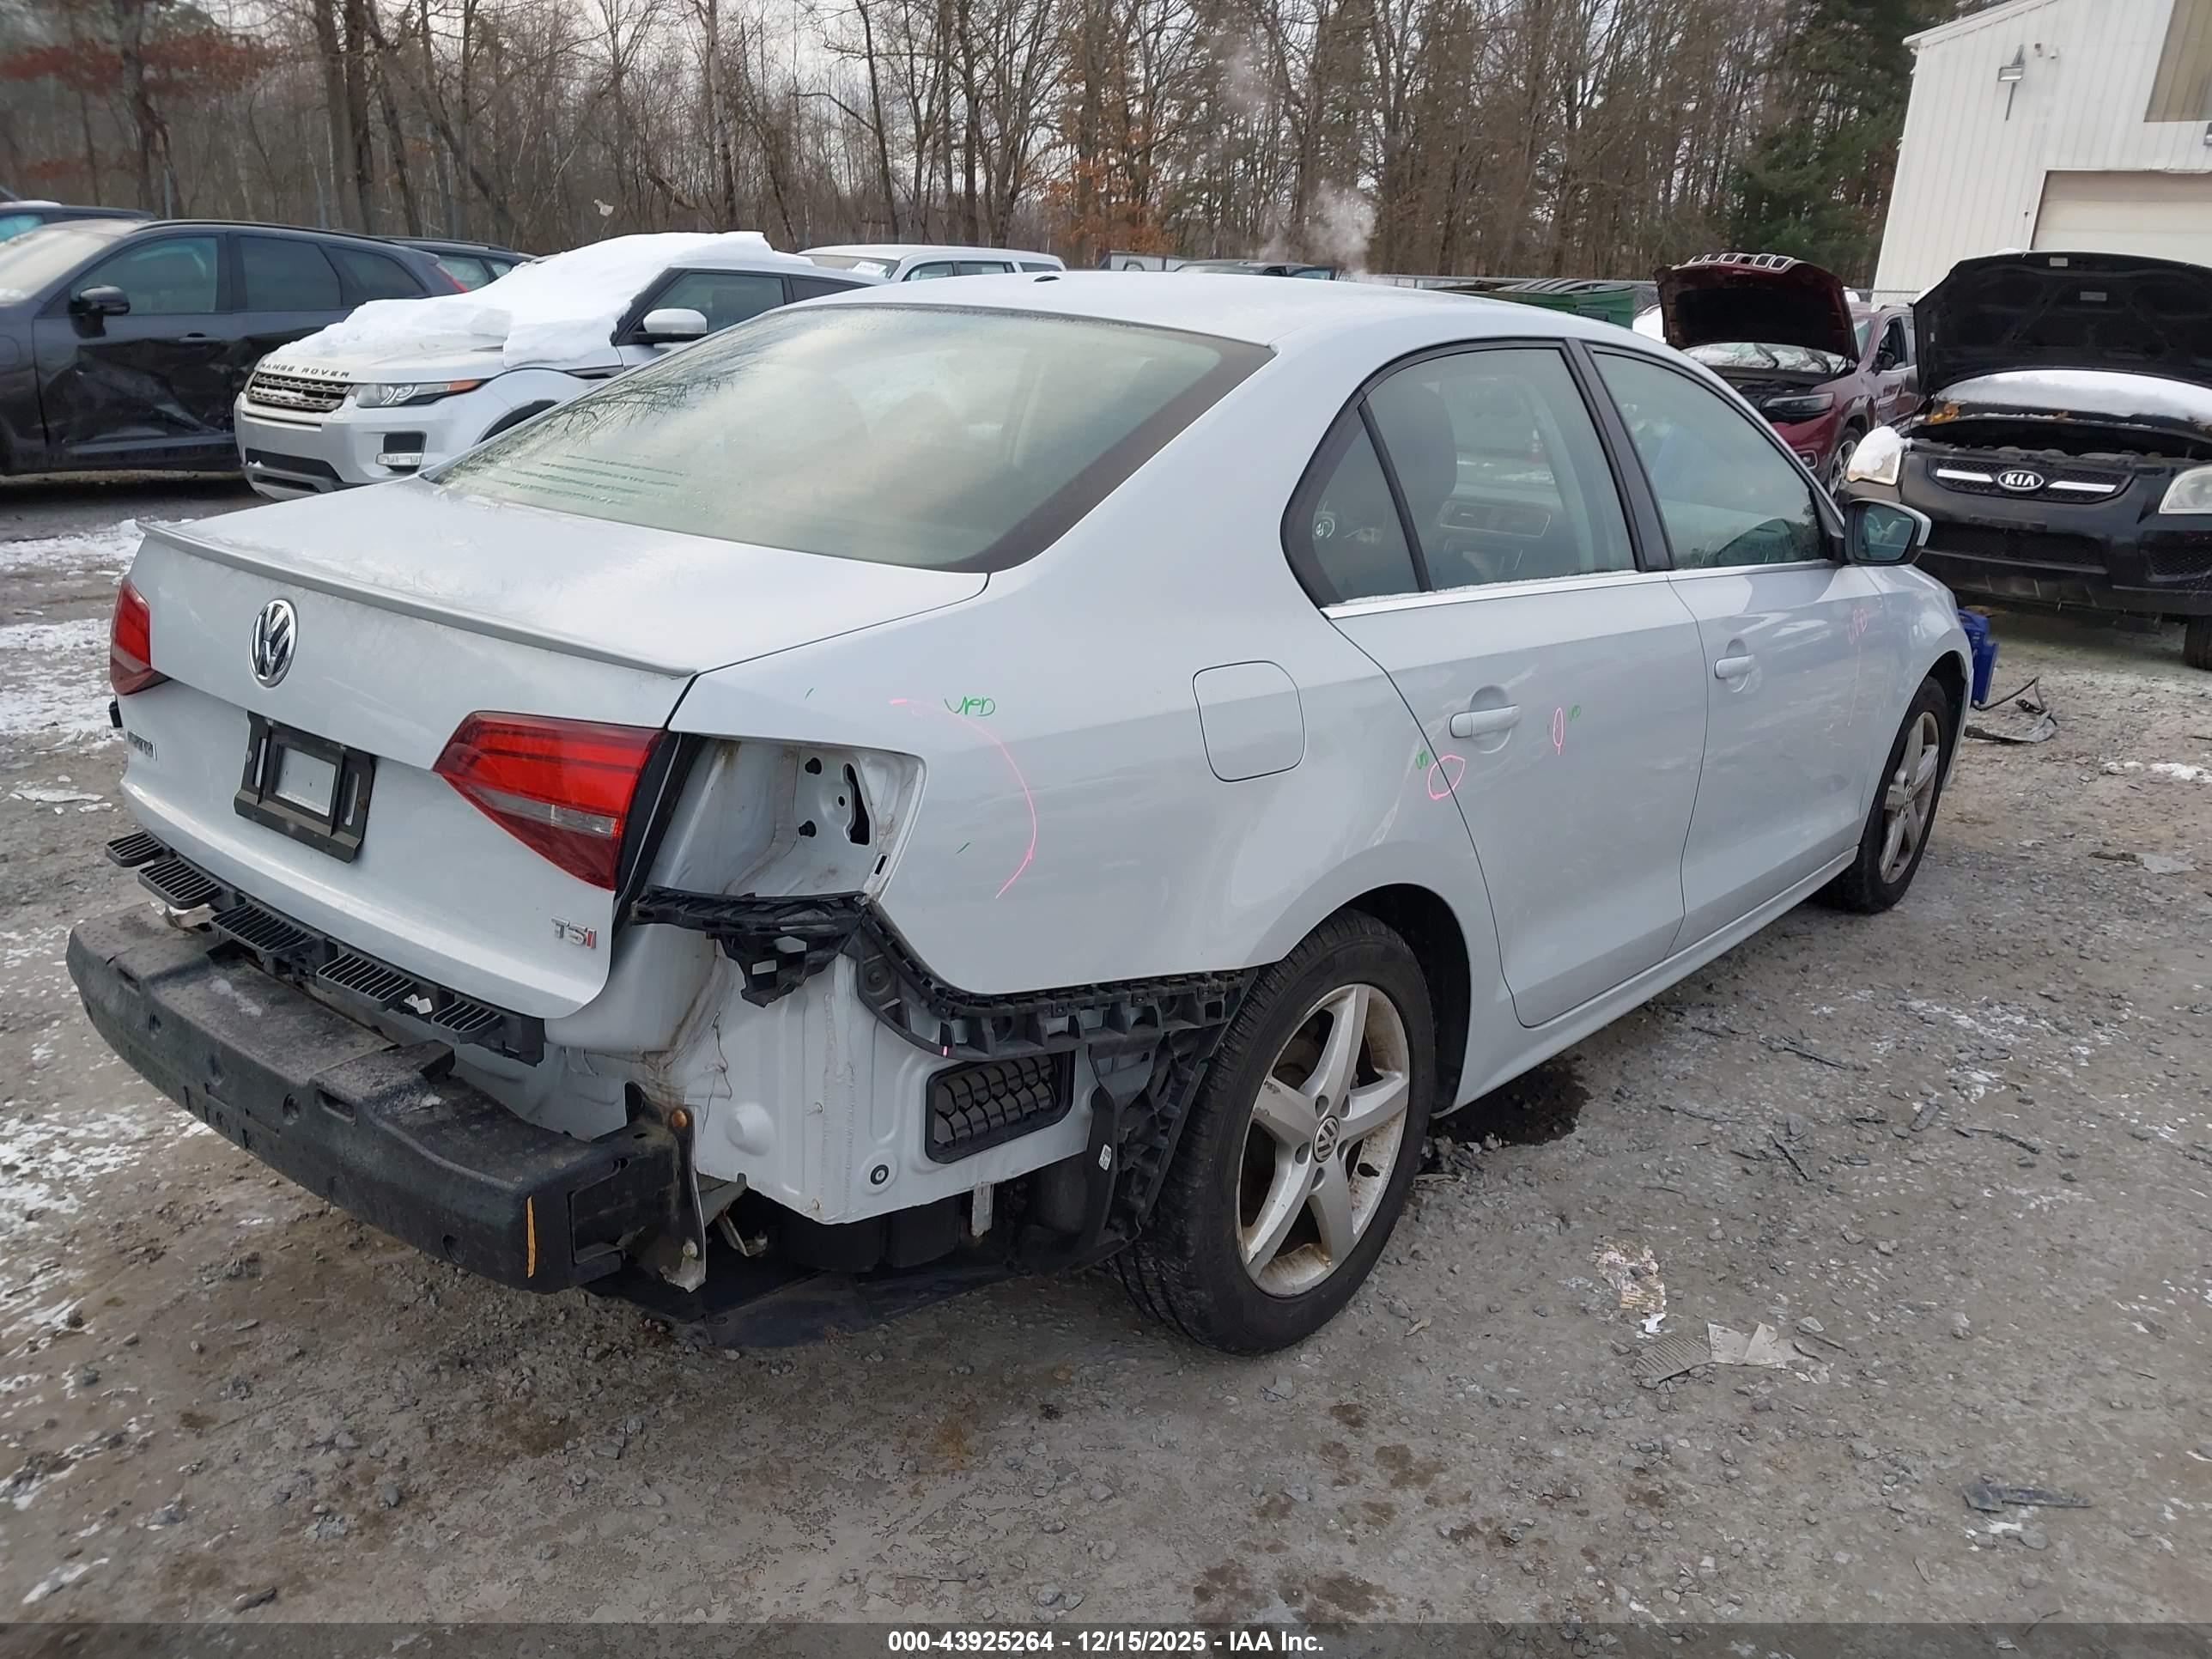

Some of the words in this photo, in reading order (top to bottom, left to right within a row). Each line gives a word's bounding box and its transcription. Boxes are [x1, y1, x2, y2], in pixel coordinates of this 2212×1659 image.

[260, 363, 295, 373] RANGE
[301, 367, 350, 379] ROVER
[2005, 473, 2035, 487] KIA
[550, 916, 597, 949] TSI
